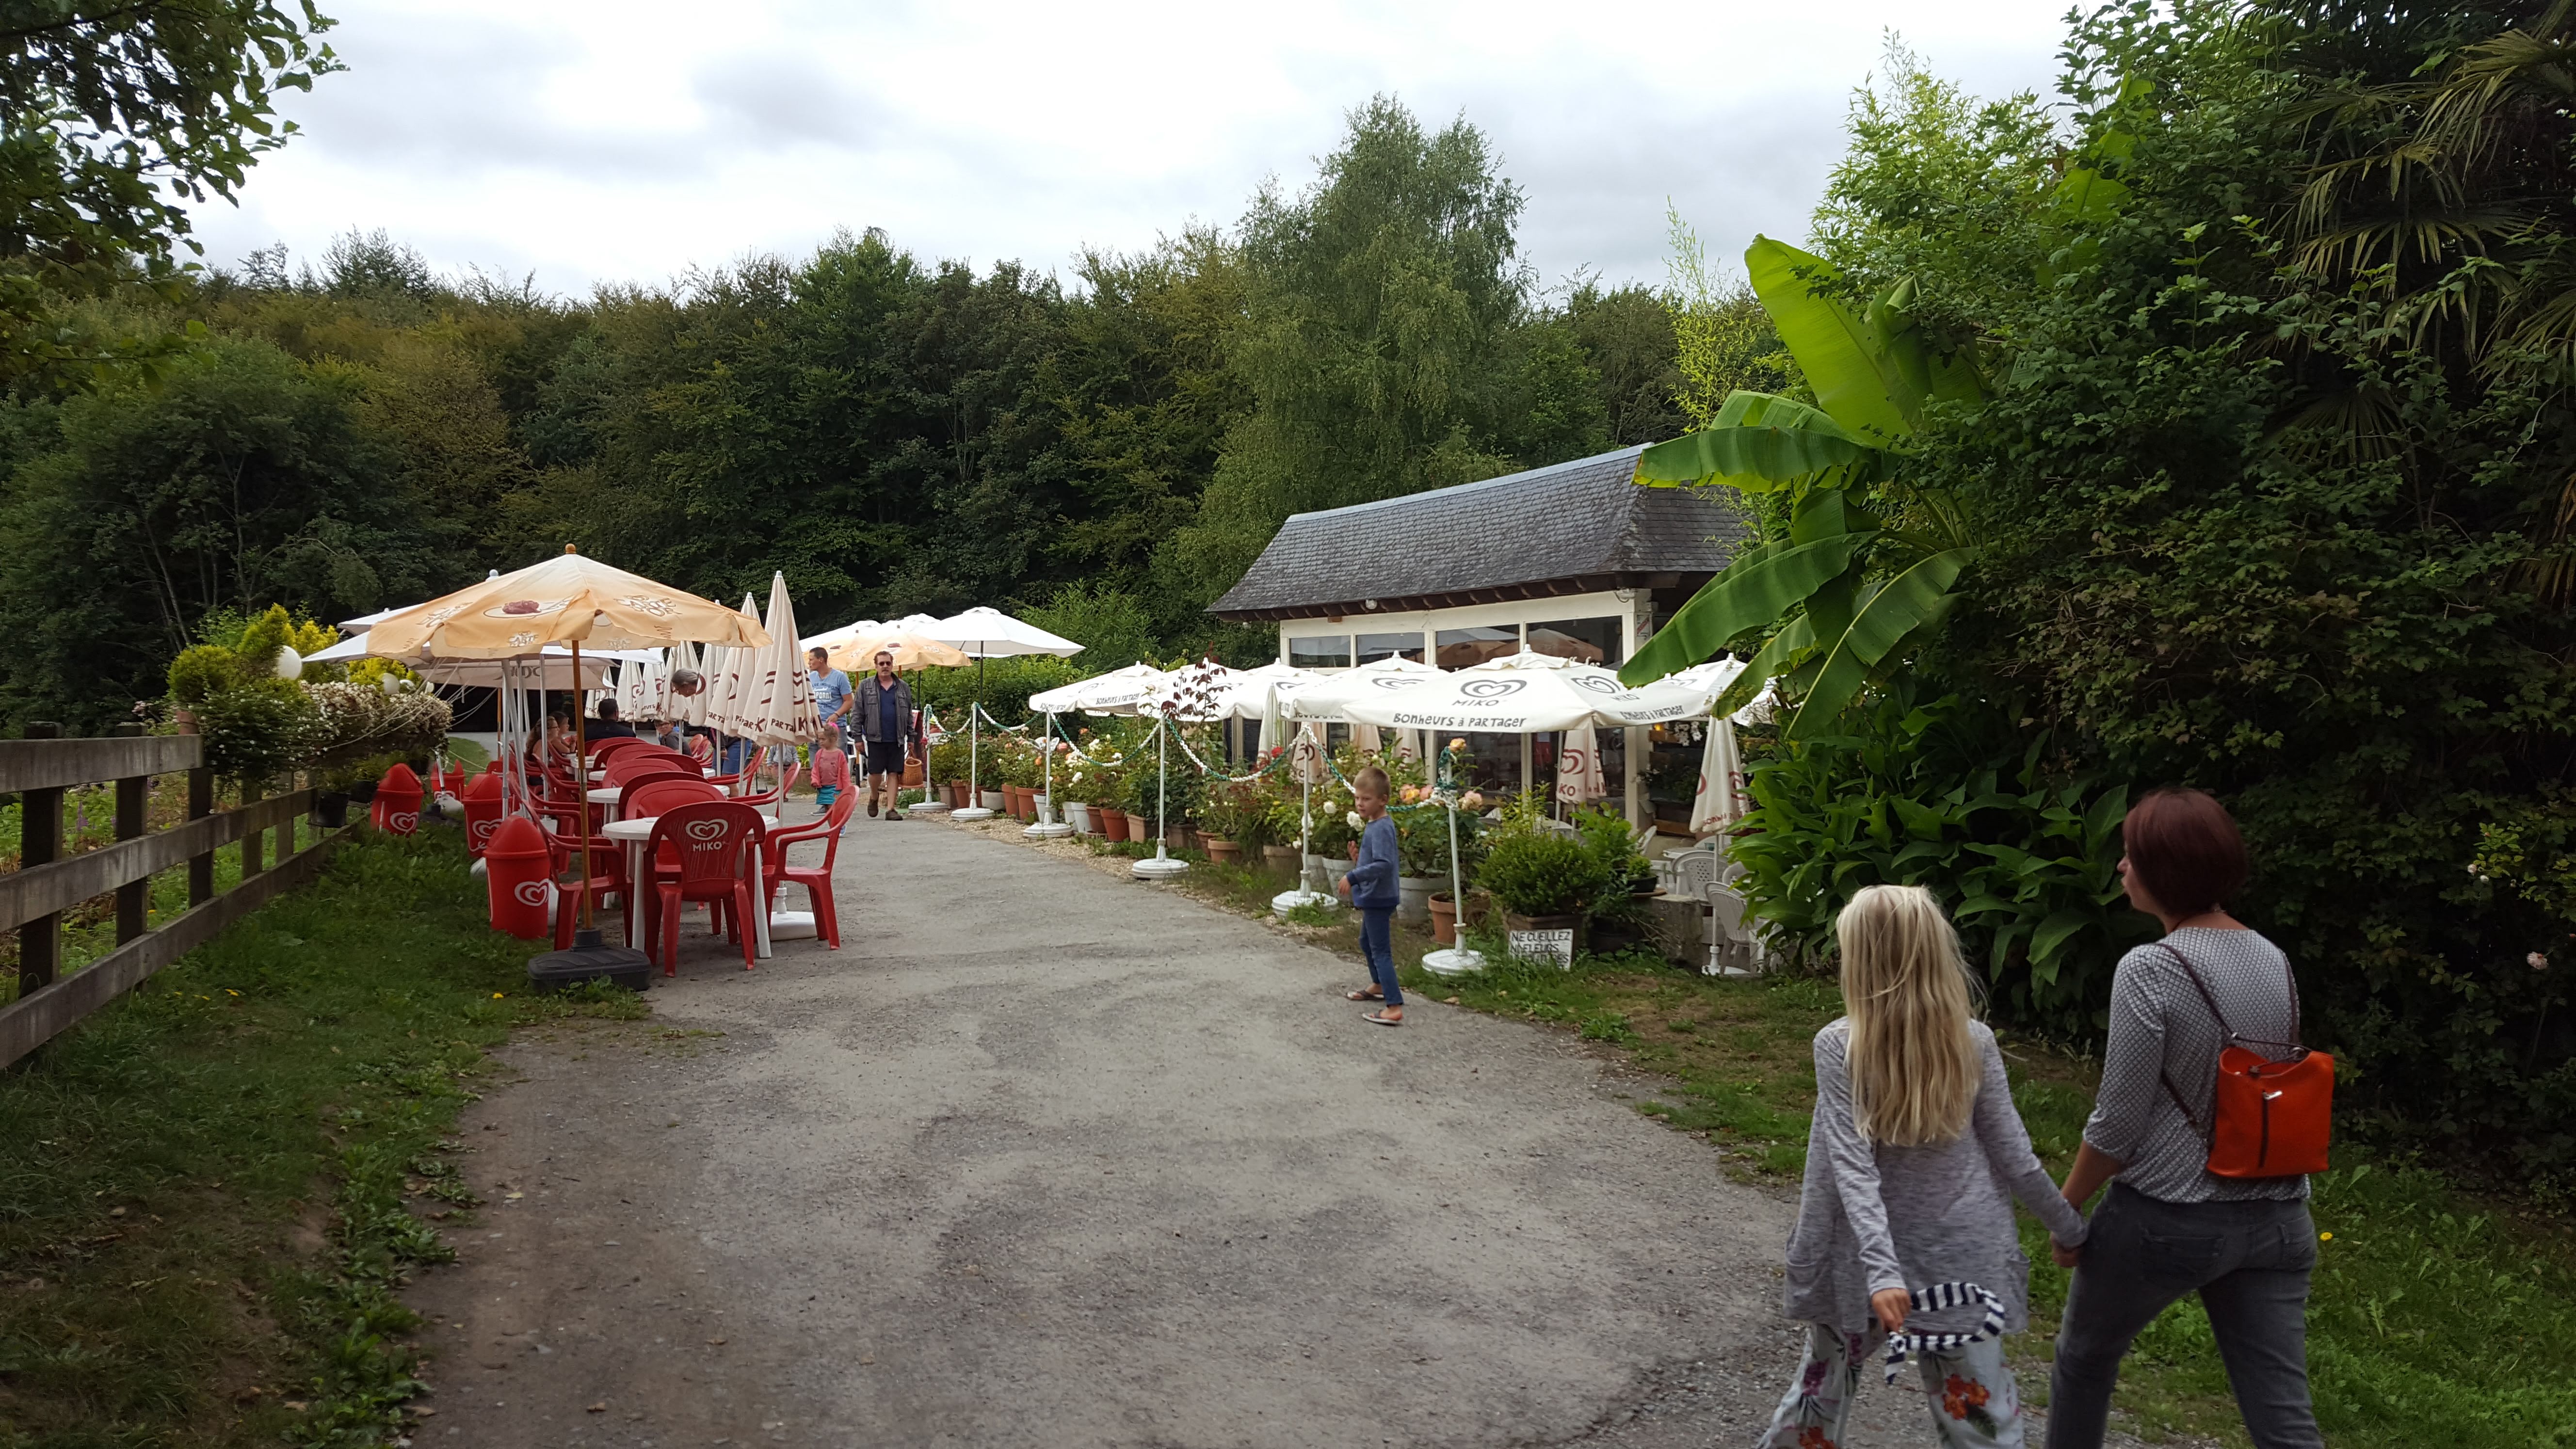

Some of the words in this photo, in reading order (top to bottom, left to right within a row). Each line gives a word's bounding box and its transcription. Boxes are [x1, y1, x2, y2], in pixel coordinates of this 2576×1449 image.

[1458, 717, 1465, 727] à
[1559, 783, 1576, 796] KO
[692, 841, 722, 852] MIKO
[1511, 932, 1525, 942] NE
[1527, 931, 1571, 942] CUEILLEZ
